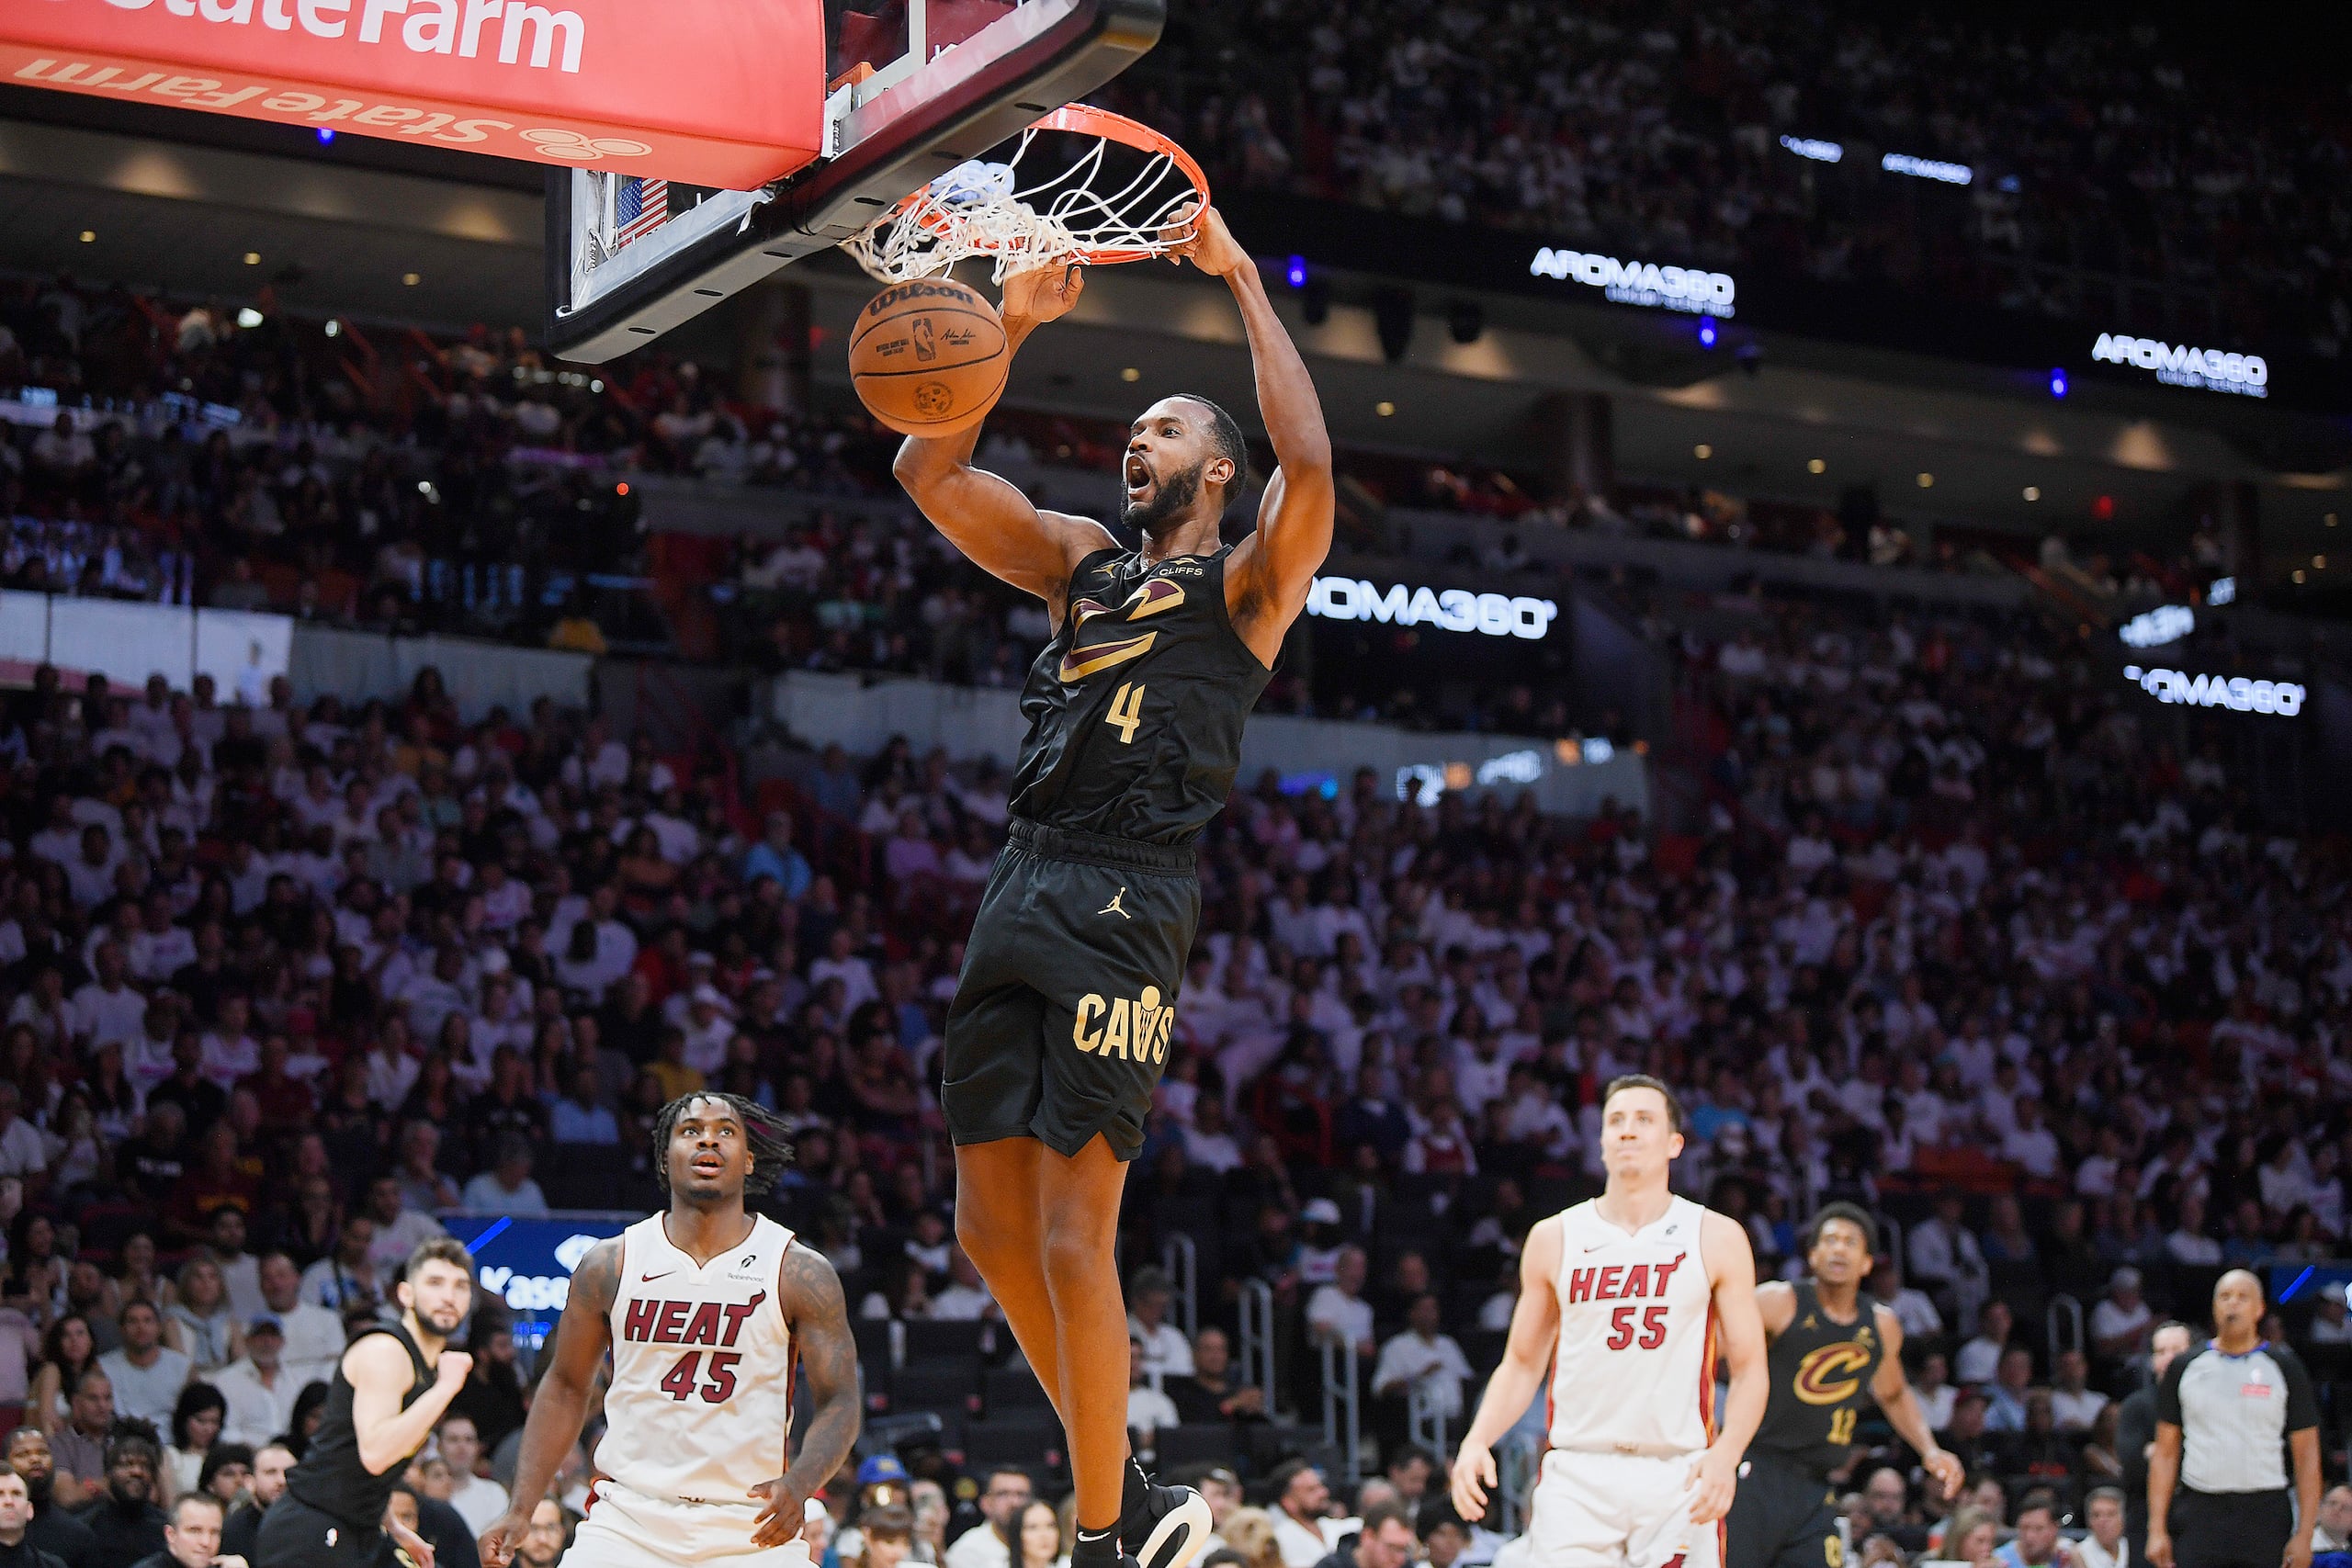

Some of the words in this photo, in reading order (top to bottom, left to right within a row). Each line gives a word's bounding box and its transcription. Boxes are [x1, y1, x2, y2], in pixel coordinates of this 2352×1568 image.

[870, 282, 974, 317] Wilson
[1159, 566, 1204, 577] CLIFFS
[1104, 681, 1147, 744] 4
[1073, 989, 1174, 1065] CAVS
[1570, 1252, 1686, 1303] HEAT
[625, 1288, 766, 1347] HEAT
[1607, 1306, 1668, 1350] 55
[661, 1350, 742, 1404] 45
